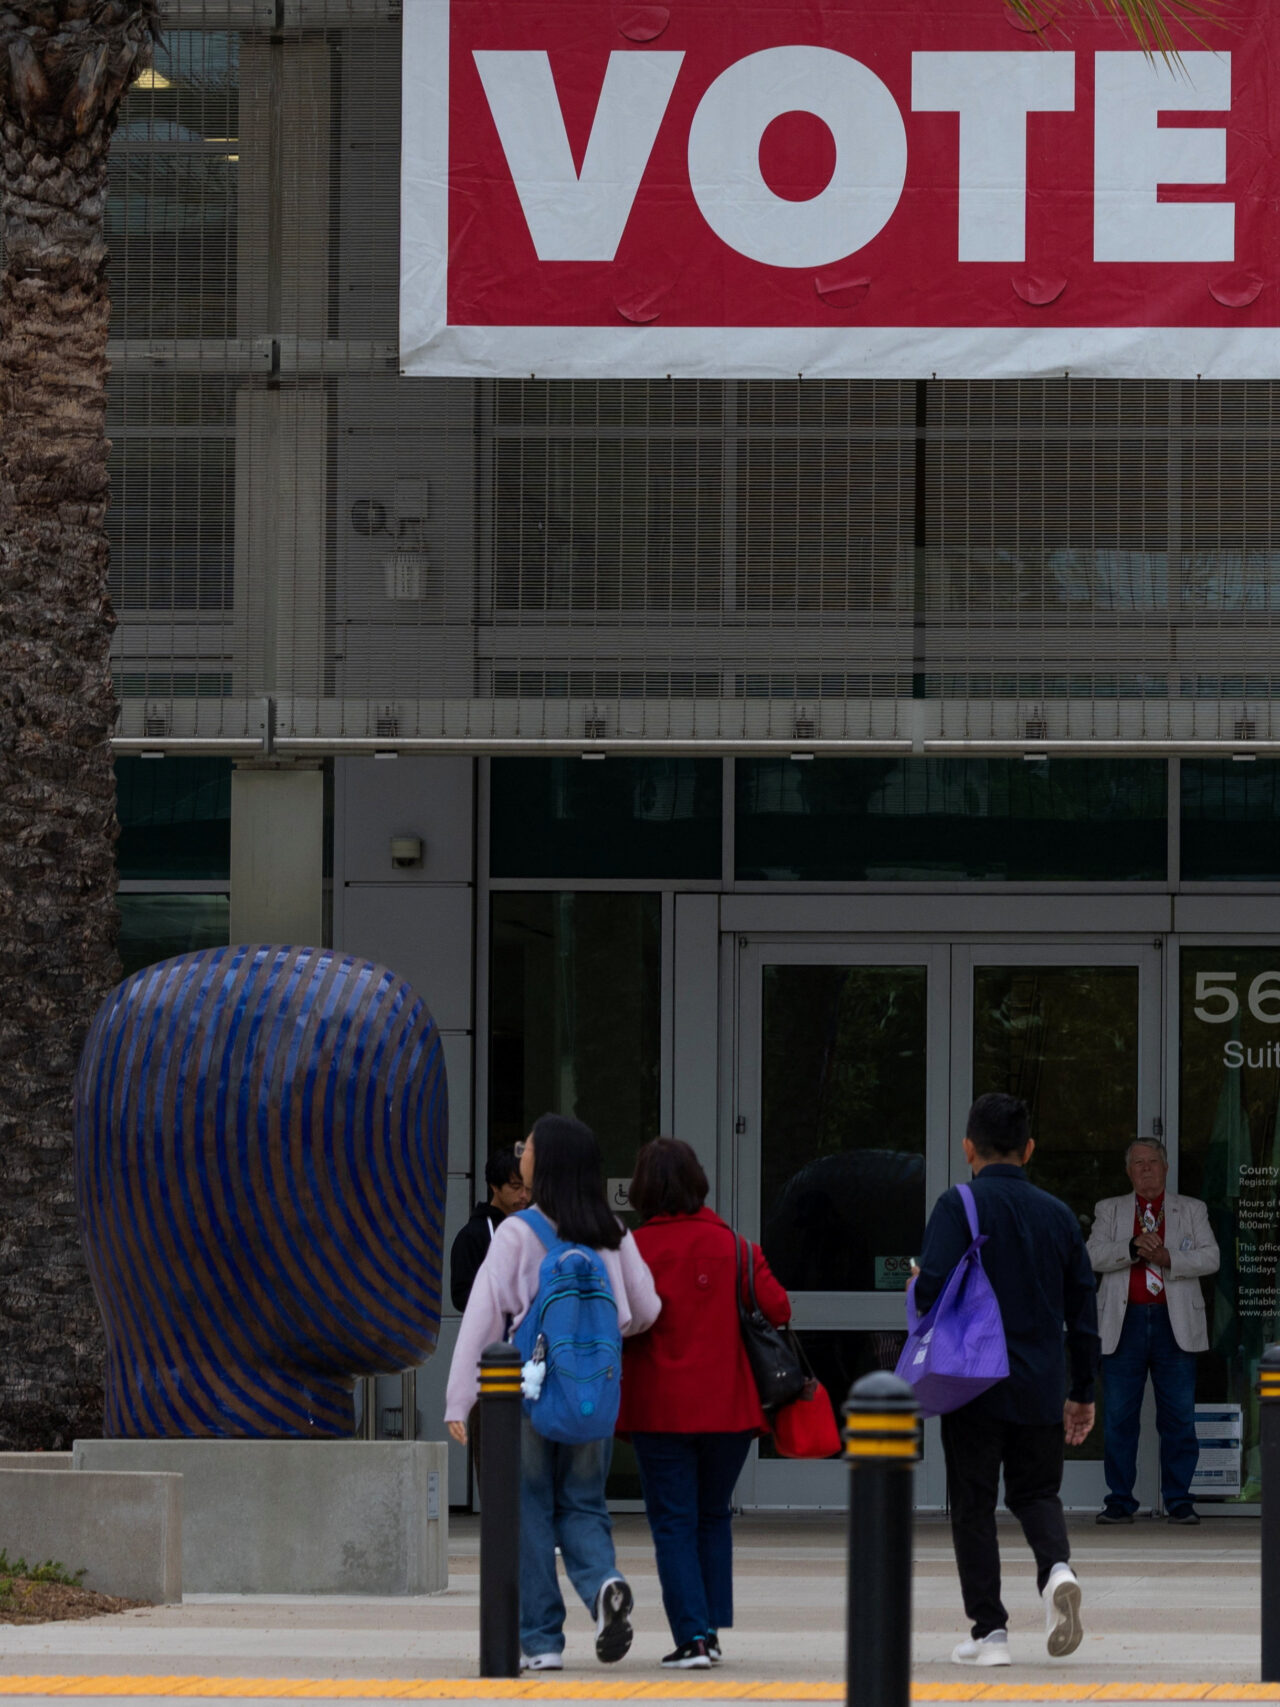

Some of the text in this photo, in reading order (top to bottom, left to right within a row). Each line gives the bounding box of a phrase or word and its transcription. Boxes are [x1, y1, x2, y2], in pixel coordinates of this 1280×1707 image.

[472, 45, 1236, 268] VOTE
[1239, 1164, 1279, 1178] County
[1239, 1178, 1277, 1188] Registrar
[1239, 1199, 1265, 1208] Hours
[1267, 1199, 1276, 1208] of
[1239, 1210, 1274, 1220] Monday
[1239, 1221, 1271, 1230] 8:00am
[1239, 1243, 1256, 1252] This
[1239, 1254, 1278, 1263] observes
[1239, 1265, 1276, 1275] Holidays
[1239, 1297, 1277, 1306] available
